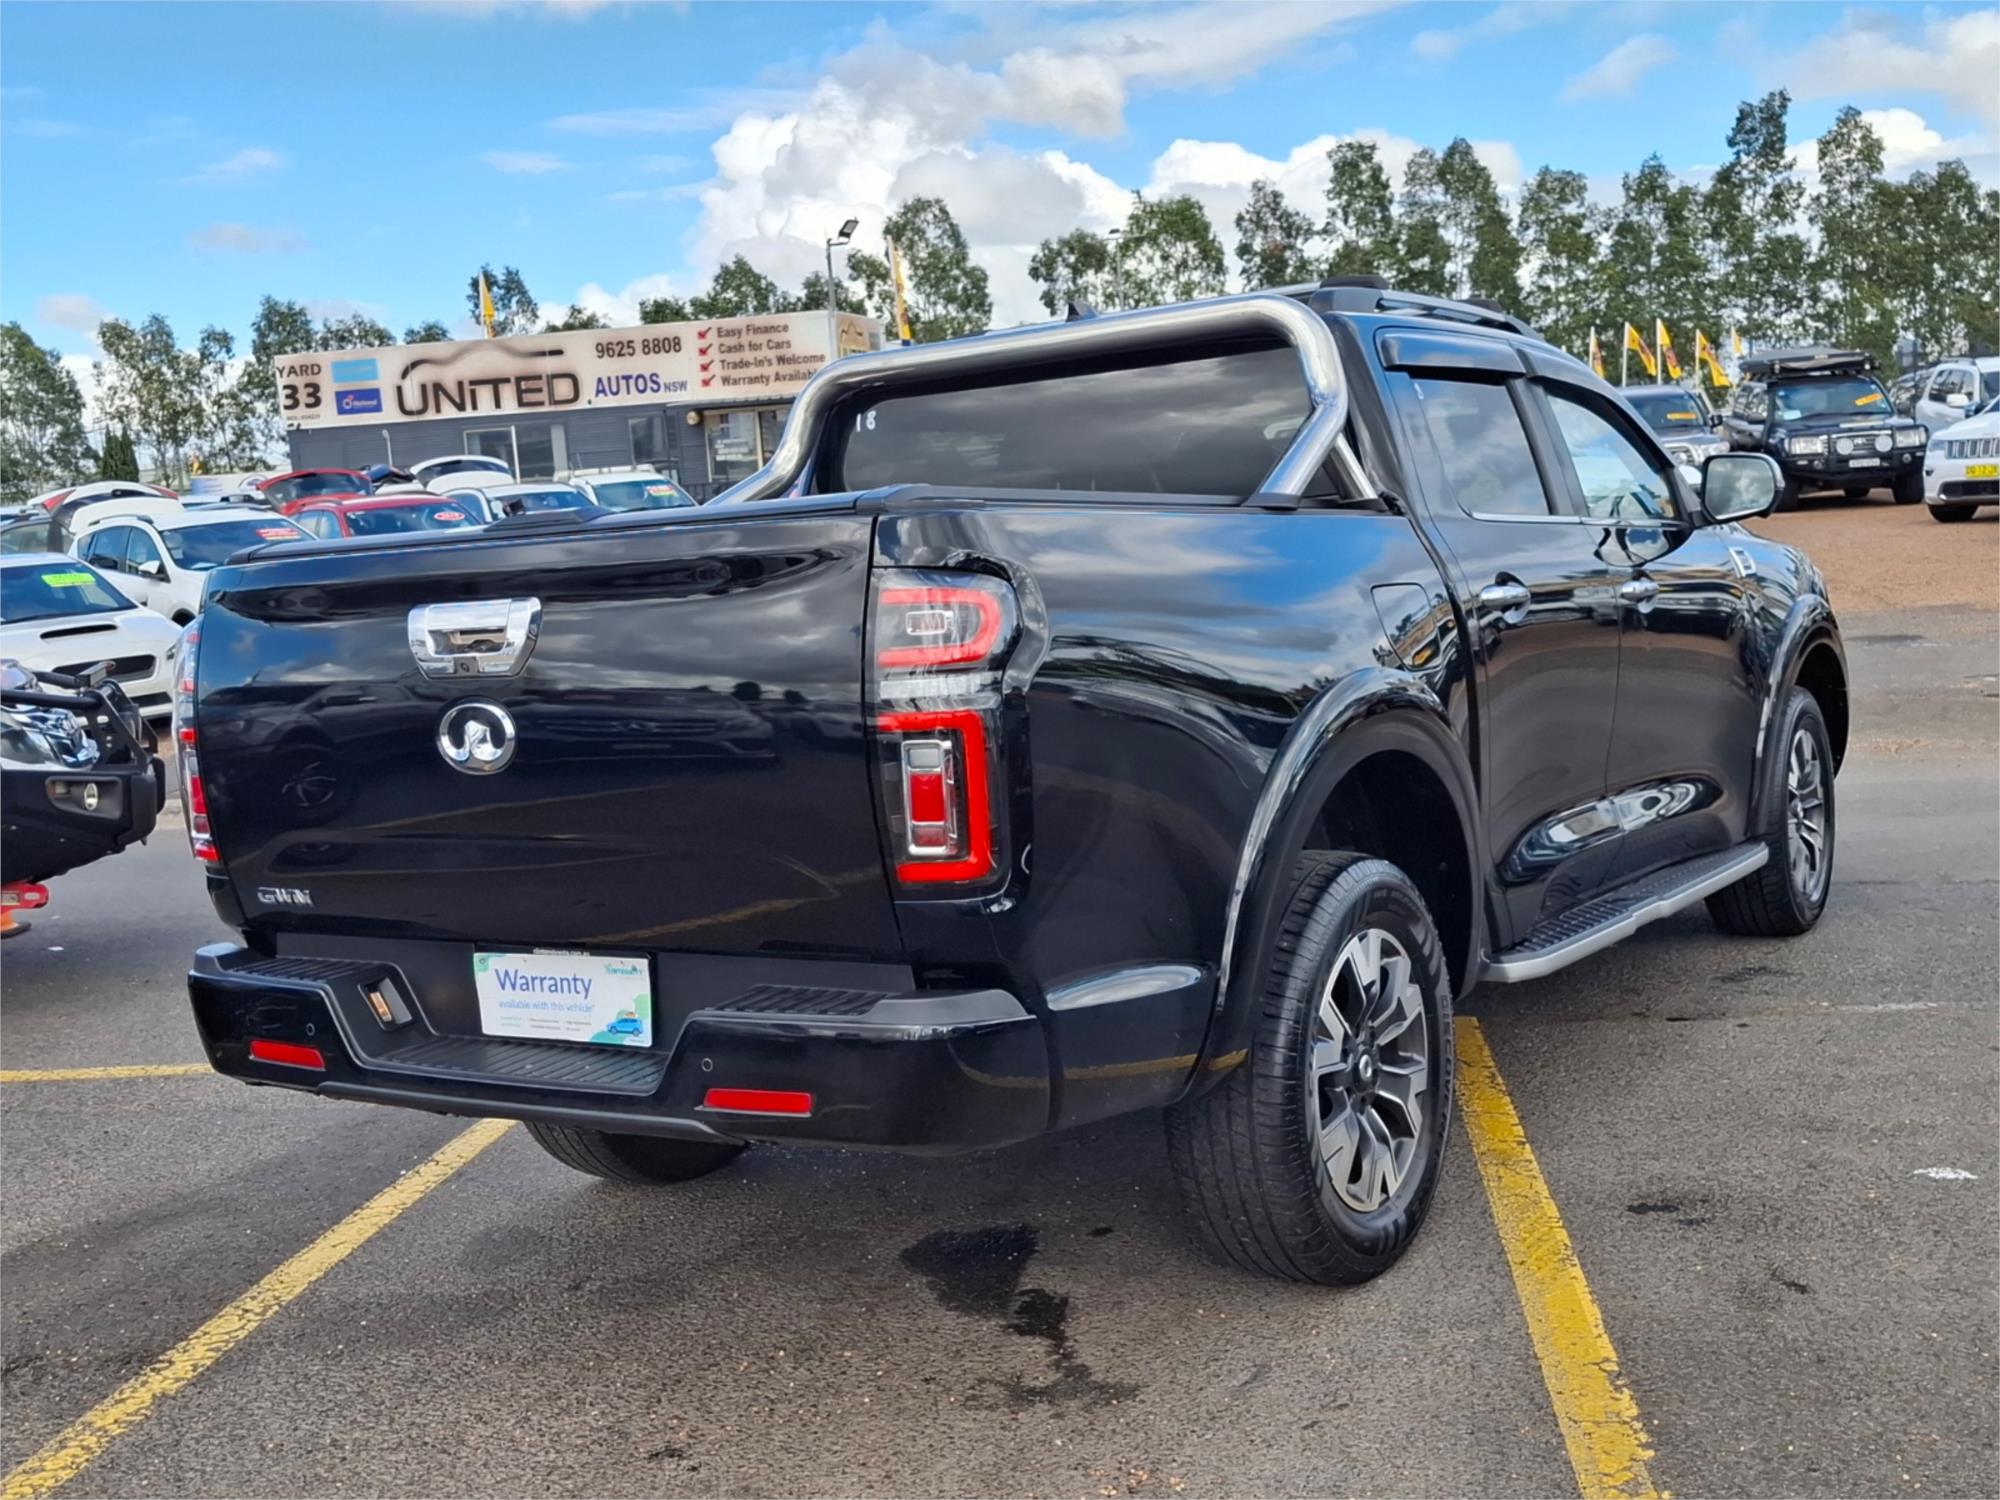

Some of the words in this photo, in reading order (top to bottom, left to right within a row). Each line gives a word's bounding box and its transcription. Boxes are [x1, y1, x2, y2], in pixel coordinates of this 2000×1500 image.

[717, 327, 743, 339] Easy
[746, 324, 789, 335] Finance
[595, 340, 636, 359] 9625
[642, 336, 682, 355] 8808
[718, 343, 745, 354] Cash
[748, 341, 762, 351] for
[766, 339, 791, 350] Cars
[276, 363, 322, 378] YARD
[720, 356, 773, 370] Trade-In's
[775, 354, 826, 366] Welcome
[595, 372, 661, 397] AUTOS
[664, 380, 688, 392] NSW
[720, 374, 770, 386] Warranty
[774, 368, 817, 382] Availabl
[282, 383, 322, 410] 33
[856, 410, 876, 432] 18
[494, 968, 592, 1000] Warranty
